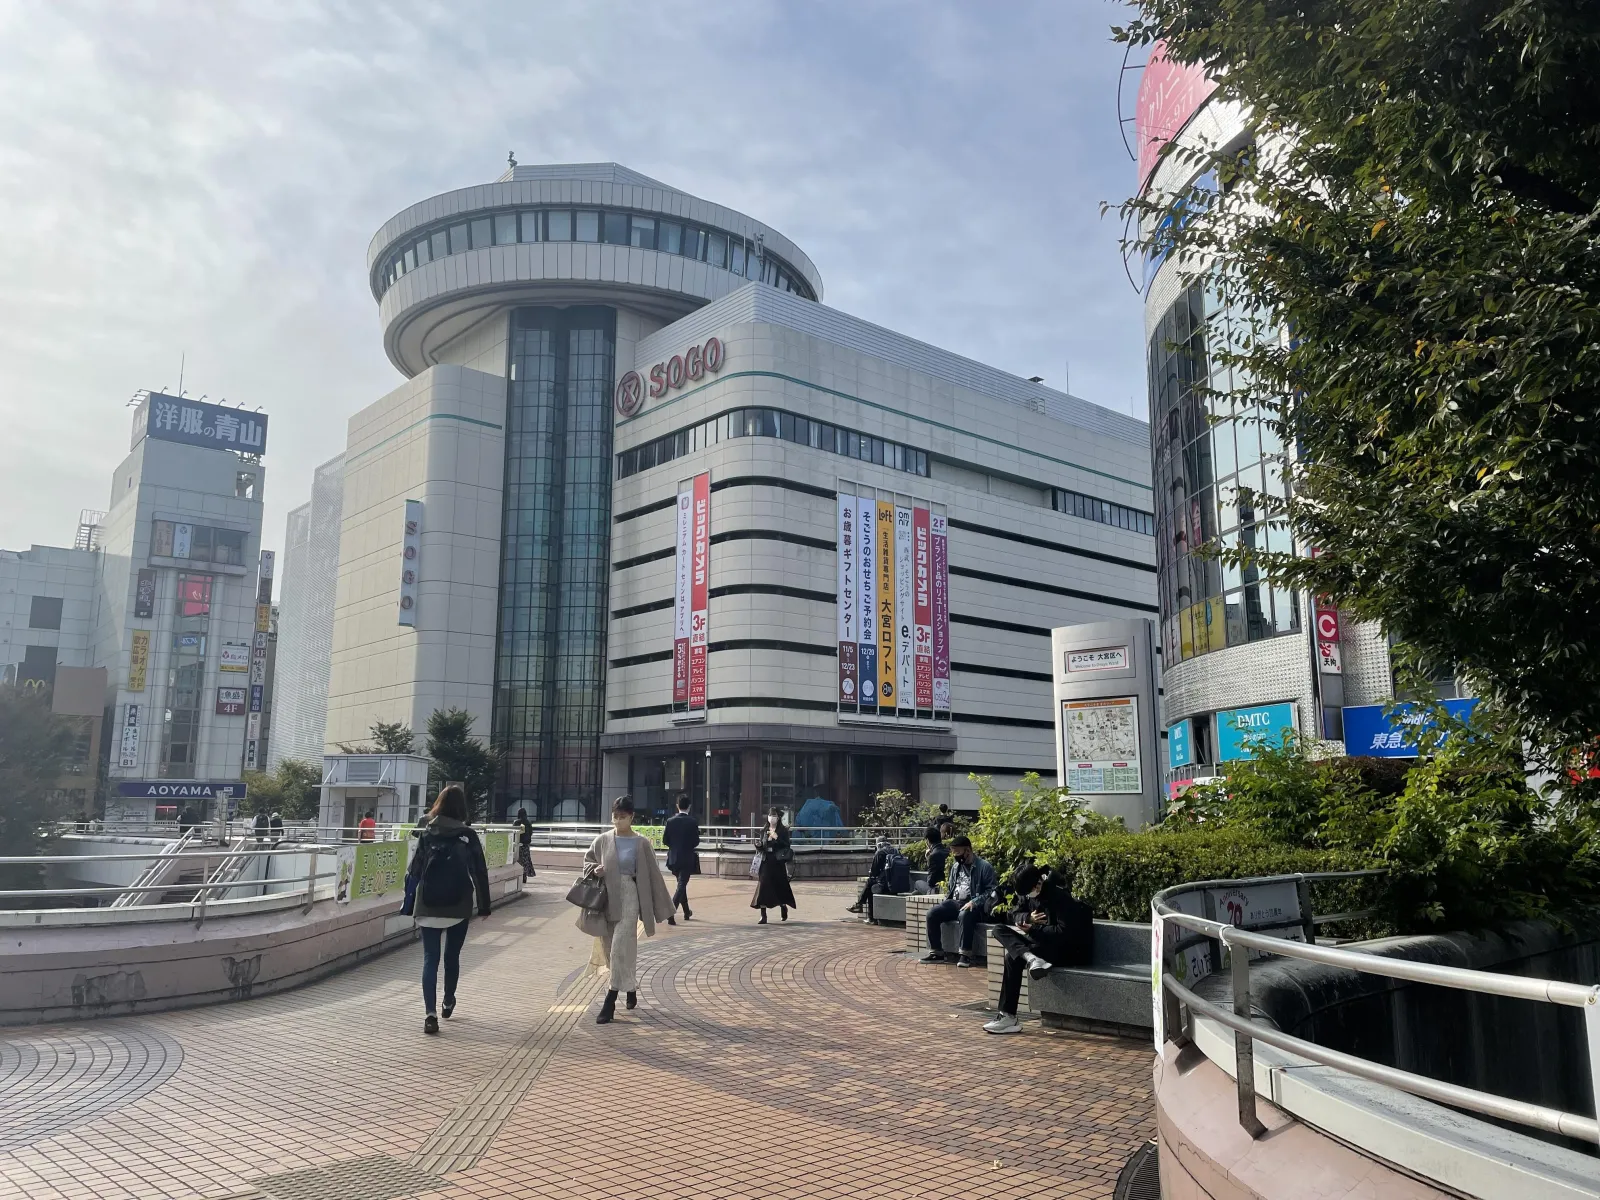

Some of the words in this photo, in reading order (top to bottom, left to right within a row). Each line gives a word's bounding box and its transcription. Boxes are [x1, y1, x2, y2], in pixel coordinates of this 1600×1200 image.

[650, 337, 724, 398] SOGO
[156, 402, 262, 446] 洋服の青山
[933, 518, 944, 529] 2F
[696, 499, 705, 585] ビックカメラ
[401, 520, 418, 610] SOGO
[843, 508, 852, 638] お歳暮ギフトセンター
[916, 526, 928, 607] ビックカメラ
[693, 614, 706, 631] 3F
[881, 599, 892, 675] 大宮ロフト
[916, 627, 930, 643] 3F
[138, 636, 148, 676] カラオケ
[842, 645, 854, 653] 11/5
[861, 647, 875, 655] 12/20
[1071, 654, 1095, 663] ようこそ
[1097, 651, 1122, 661] 大宮区へ
[841, 662, 856, 671] 12/23
[917, 664, 931, 672] エアコン
[1323, 658, 1337, 667] 天狗
[223, 704, 238, 713] 4F
[147, 785, 212, 796] AOYAMA
[1219, 889, 1250, 909] Anniversary
